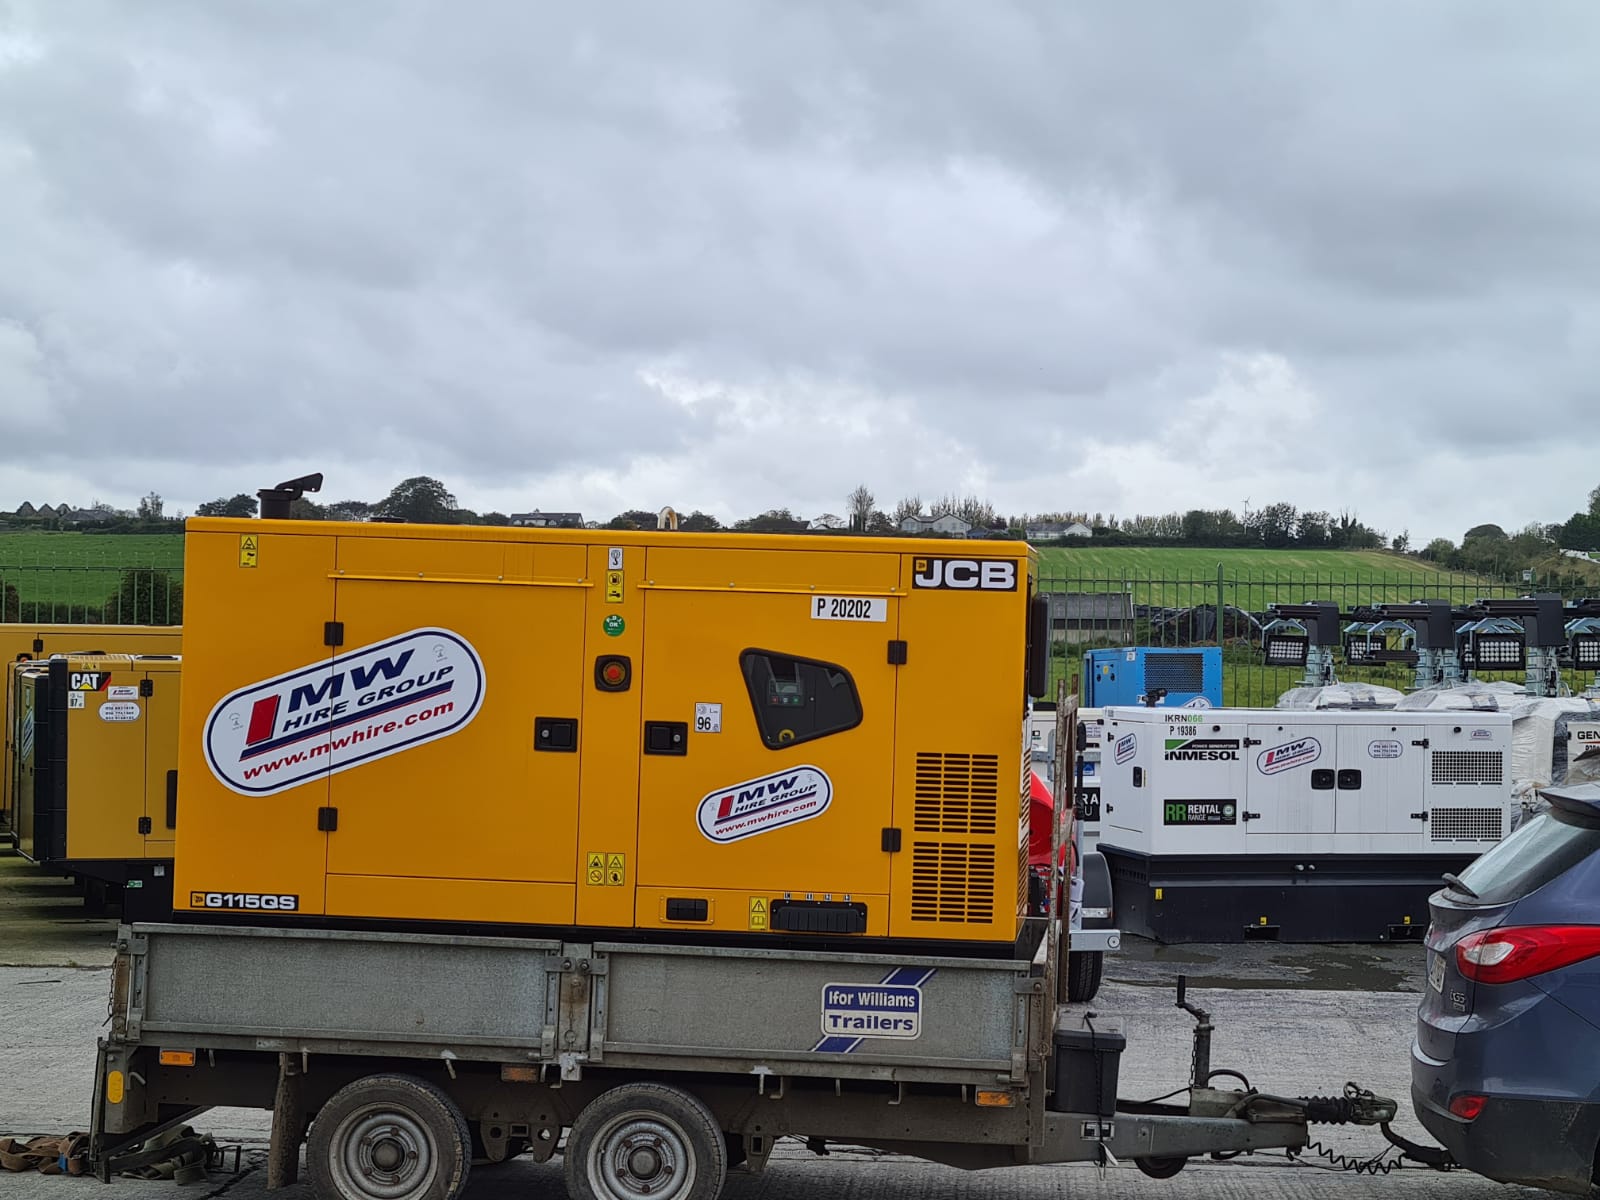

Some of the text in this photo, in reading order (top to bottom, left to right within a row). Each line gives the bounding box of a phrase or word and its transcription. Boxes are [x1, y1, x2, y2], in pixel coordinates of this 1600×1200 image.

[915, 560, 1015, 589] JCB
[817, 598, 871, 618] P 20202
[71, 673, 99, 690] CAT
[287, 648, 416, 713] MW
[282, 666, 454, 733] HIRE GROUP
[697, 716, 711, 730] 96
[1169, 725, 1197, 736] P 19386
[243, 701, 454, 780] www.mwhire.com
[1276, 741, 1306, 756] MW
[735, 784, 818, 813] HIRE GROUP
[737, 775, 799, 804] MW
[715, 801, 817, 835] www.mwhire.com
[1165, 804, 1220, 821] RR RENTAL
[206, 893, 296, 910] G115QS
[828, 990, 915, 1008] Ifor Williams
[828, 1014, 914, 1031] Trailers
